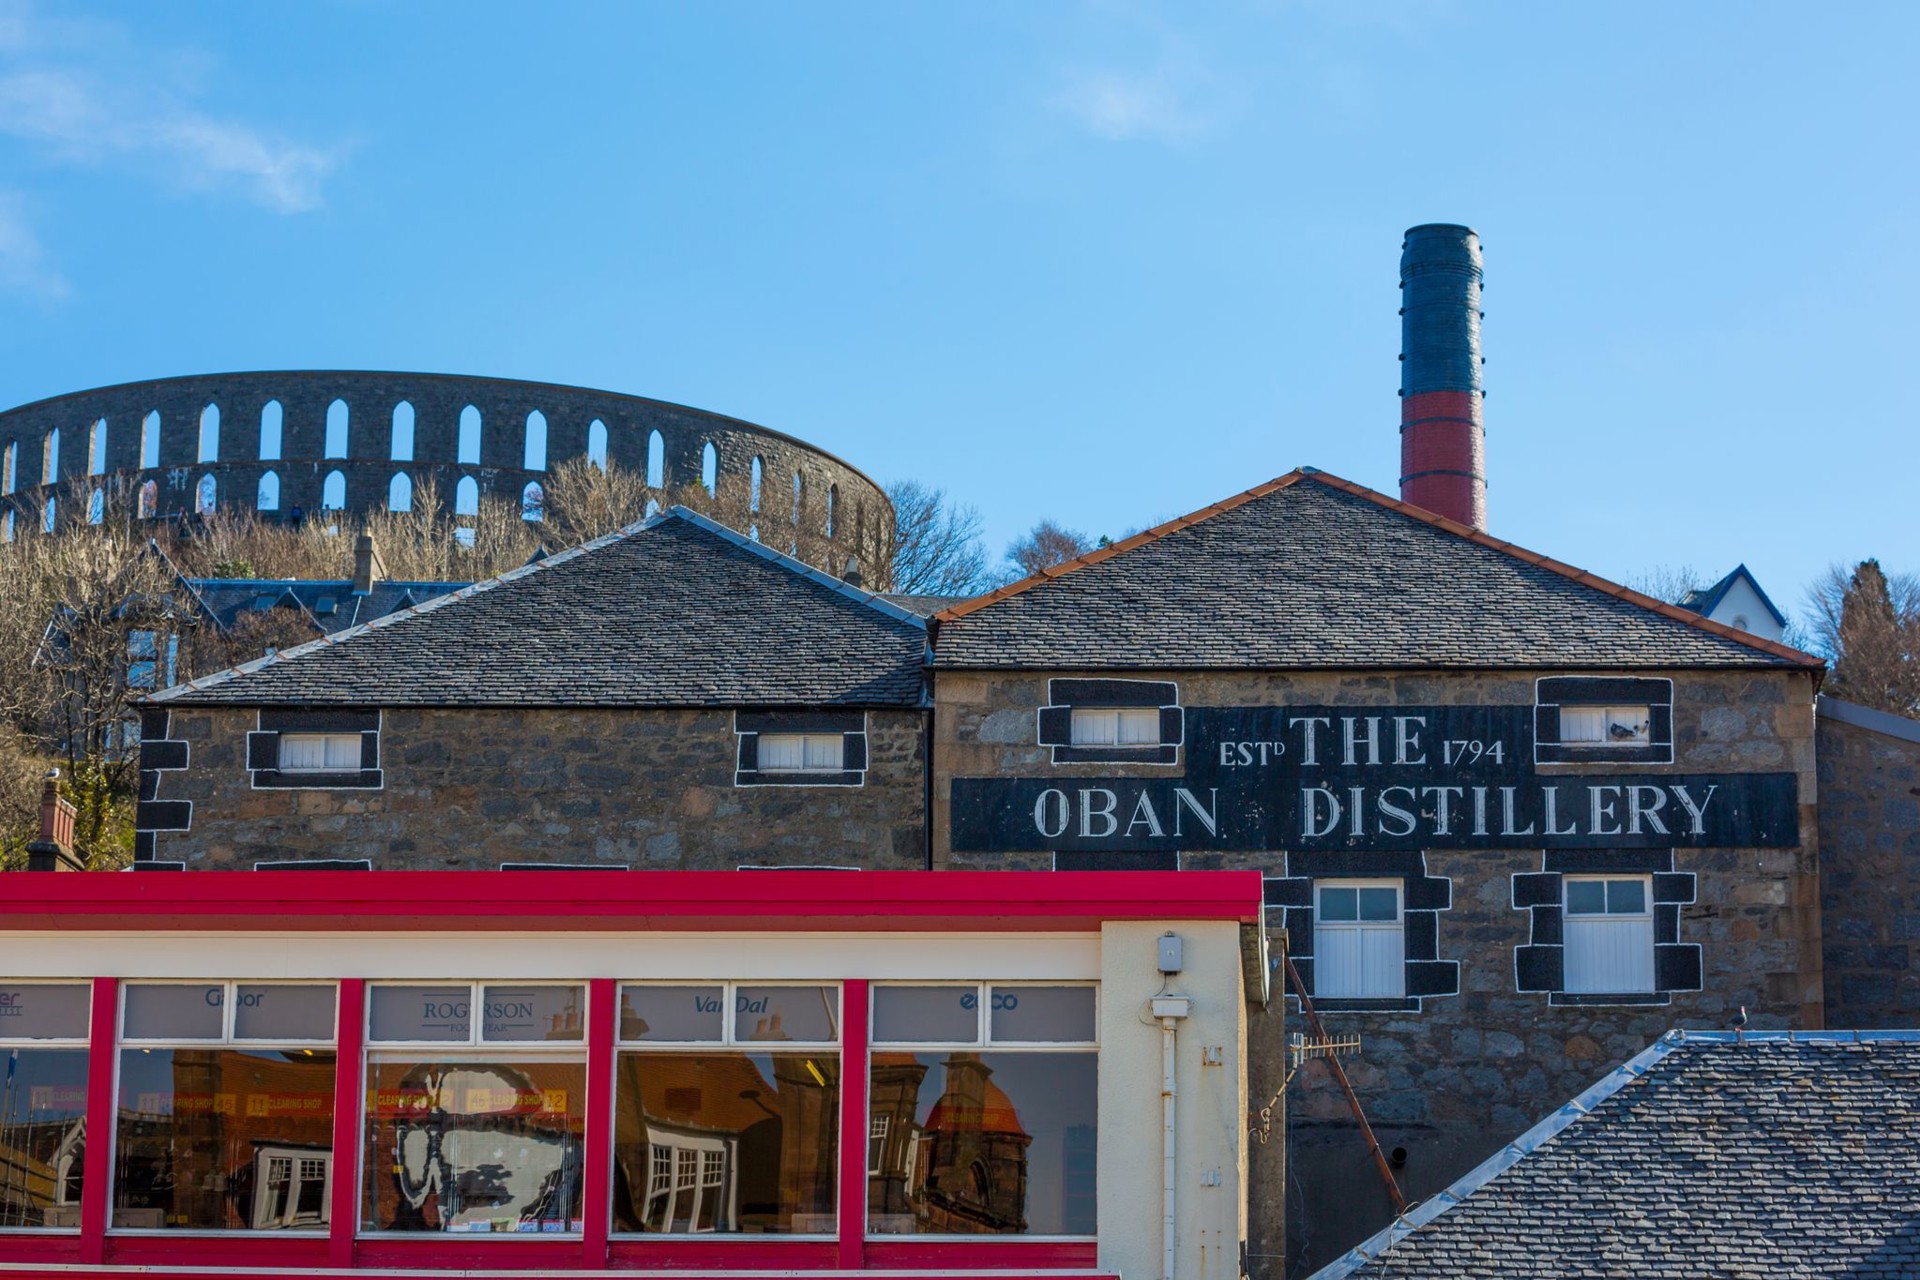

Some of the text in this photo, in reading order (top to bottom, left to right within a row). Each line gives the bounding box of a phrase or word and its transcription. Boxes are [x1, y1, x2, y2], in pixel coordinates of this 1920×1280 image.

[1289, 715, 1427, 767] THE
[1443, 739, 1505, 767] 1794
[1033, 784, 1719, 838] OBAN DISTILLERY
[205, 988, 265, 1008] Gor
[960, 992, 1018, 1011] eco
[423, 1002, 534, 1019] ROGRSON
